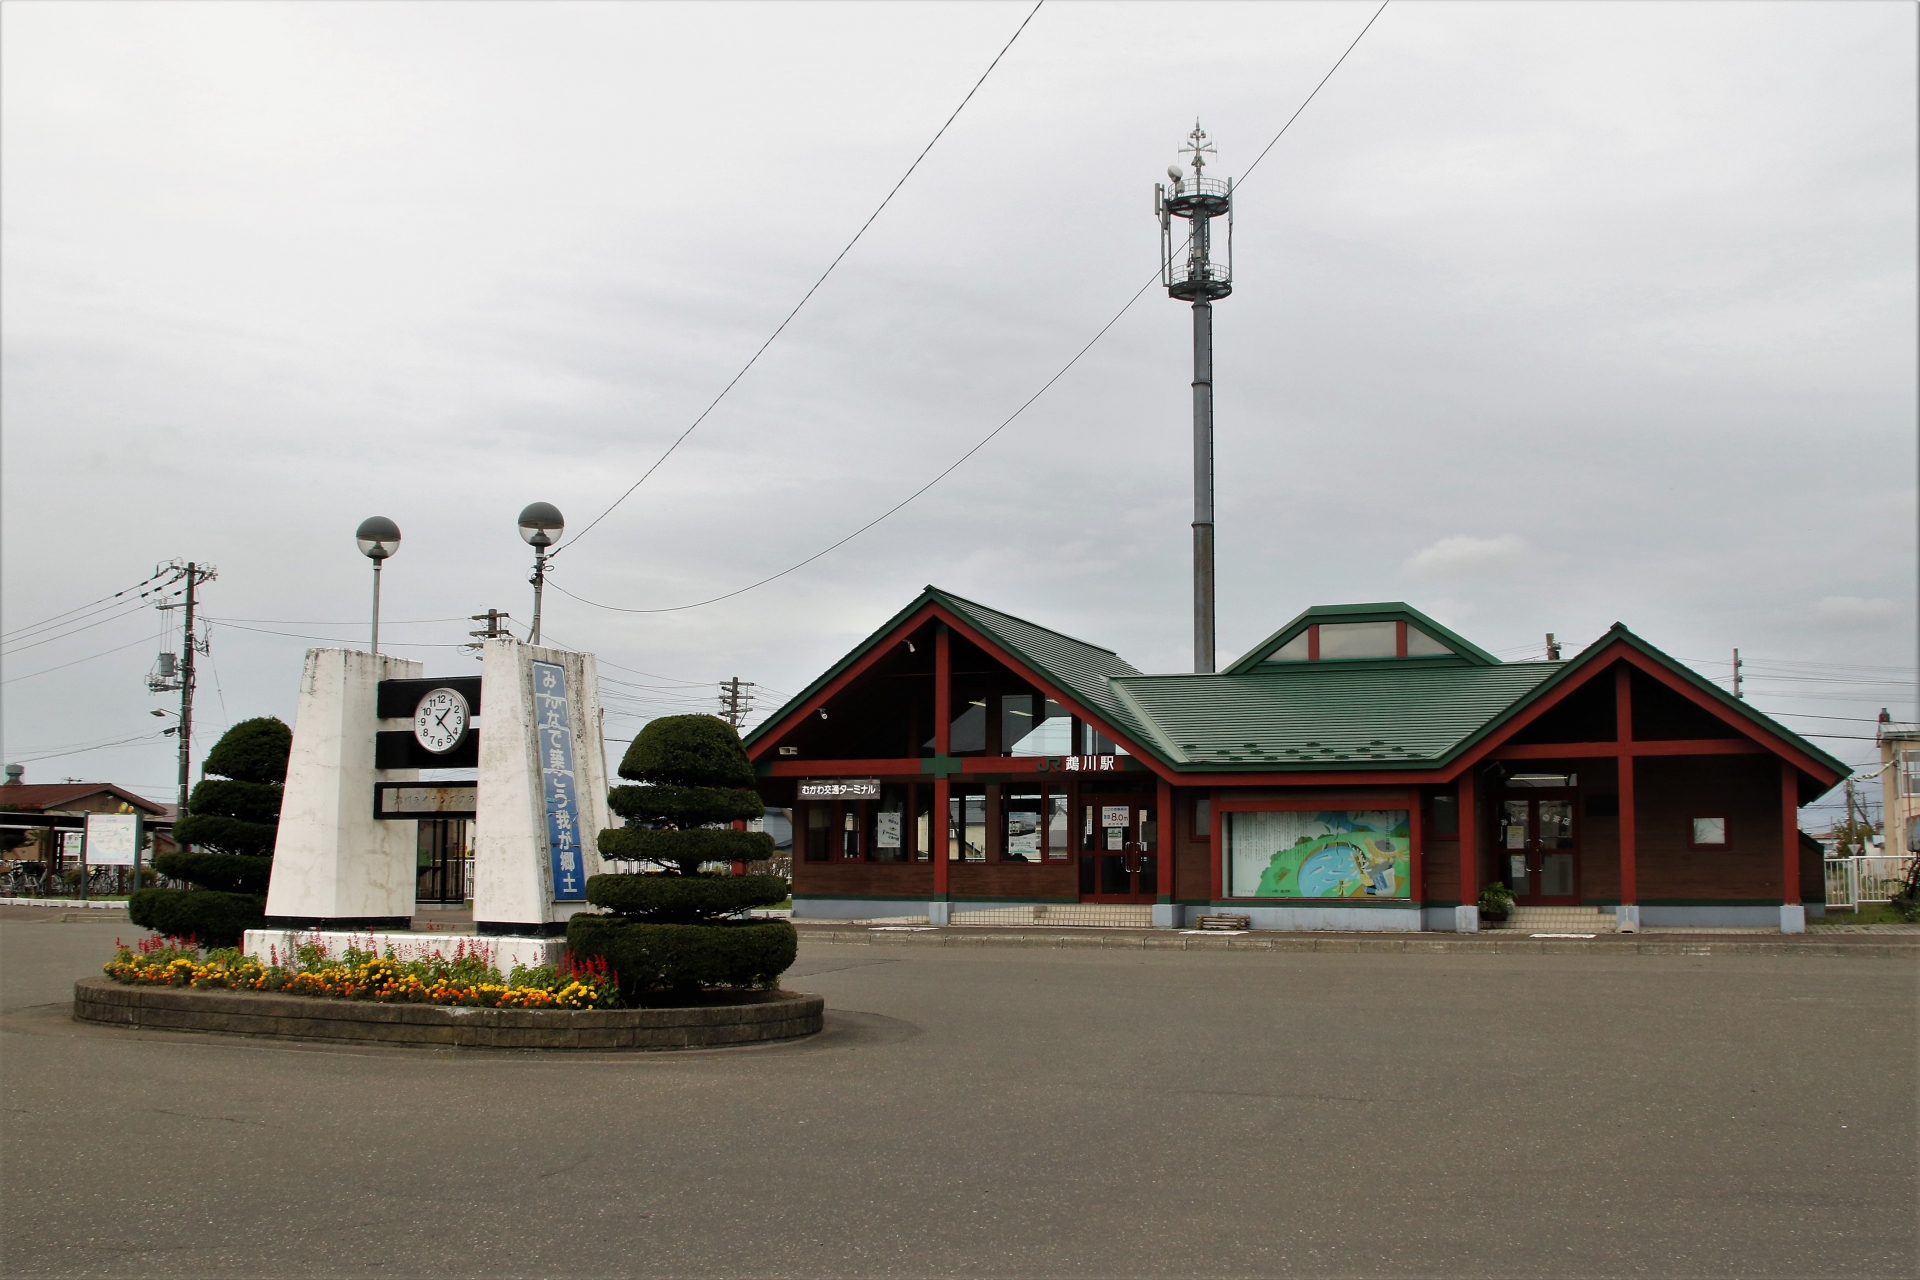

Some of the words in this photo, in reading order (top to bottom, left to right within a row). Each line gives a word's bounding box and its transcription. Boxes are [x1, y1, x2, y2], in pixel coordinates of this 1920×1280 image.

[429, 699, 436, 707] 11
[437, 695, 445, 703] 12
[448, 698, 453, 706] 1
[422, 708, 431, 716] 10
[454, 705, 459, 713] 2
[420, 718, 426, 726] 9
[456, 716, 462, 724] 3
[453, 727, 458, 735] 4
[429, 736, 435, 744] 7
[437, 738, 443, 746] 6
[446, 735, 452, 743] 5
[1036, 756, 1062, 771] JR
[1065, 755, 1115, 771] 鵡川駅
[541, 670, 578, 893] みんなで築こう我が郷土
[801, 784, 876, 795] むかわ交通ターミナル
